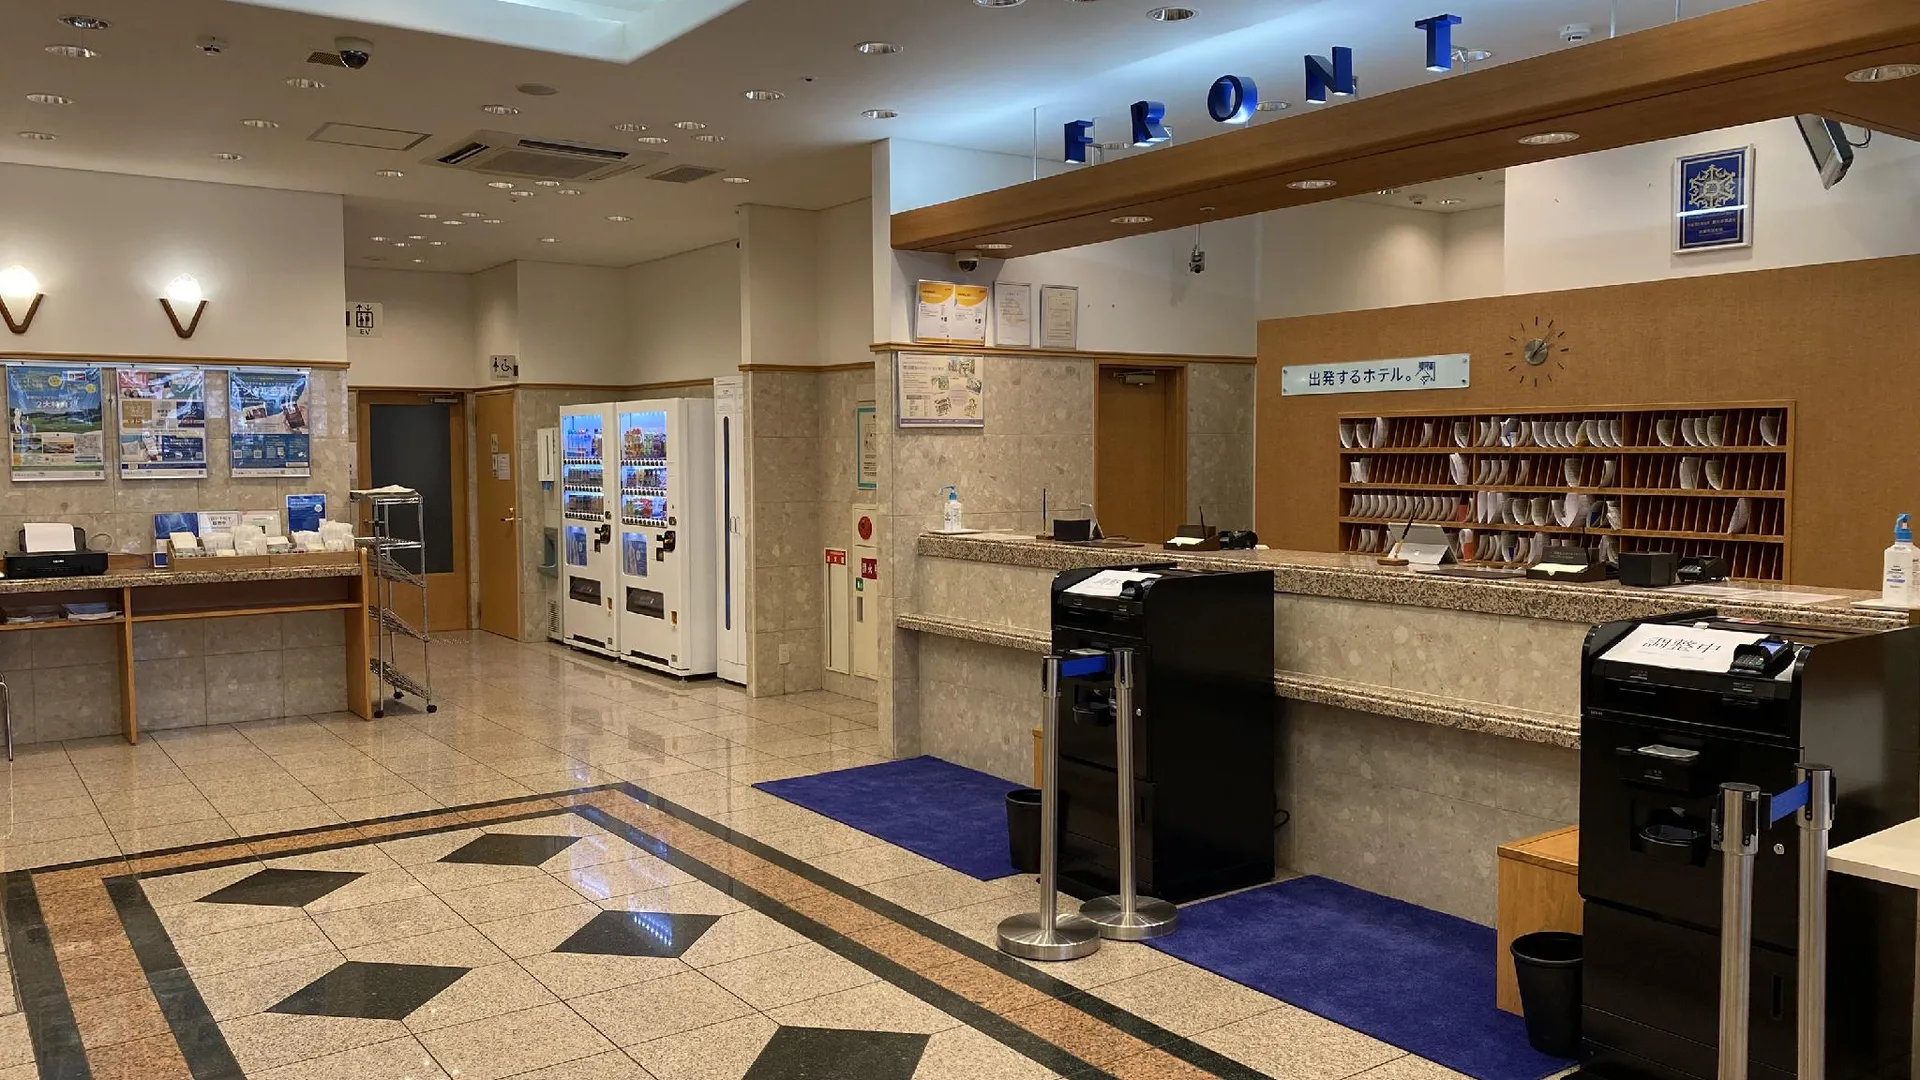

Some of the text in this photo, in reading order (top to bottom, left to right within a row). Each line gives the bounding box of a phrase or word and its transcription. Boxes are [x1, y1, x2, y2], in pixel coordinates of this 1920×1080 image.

[1064, 14, 1462, 164] FRONT
[1309, 367, 1411, 387] 出発するホテル。
